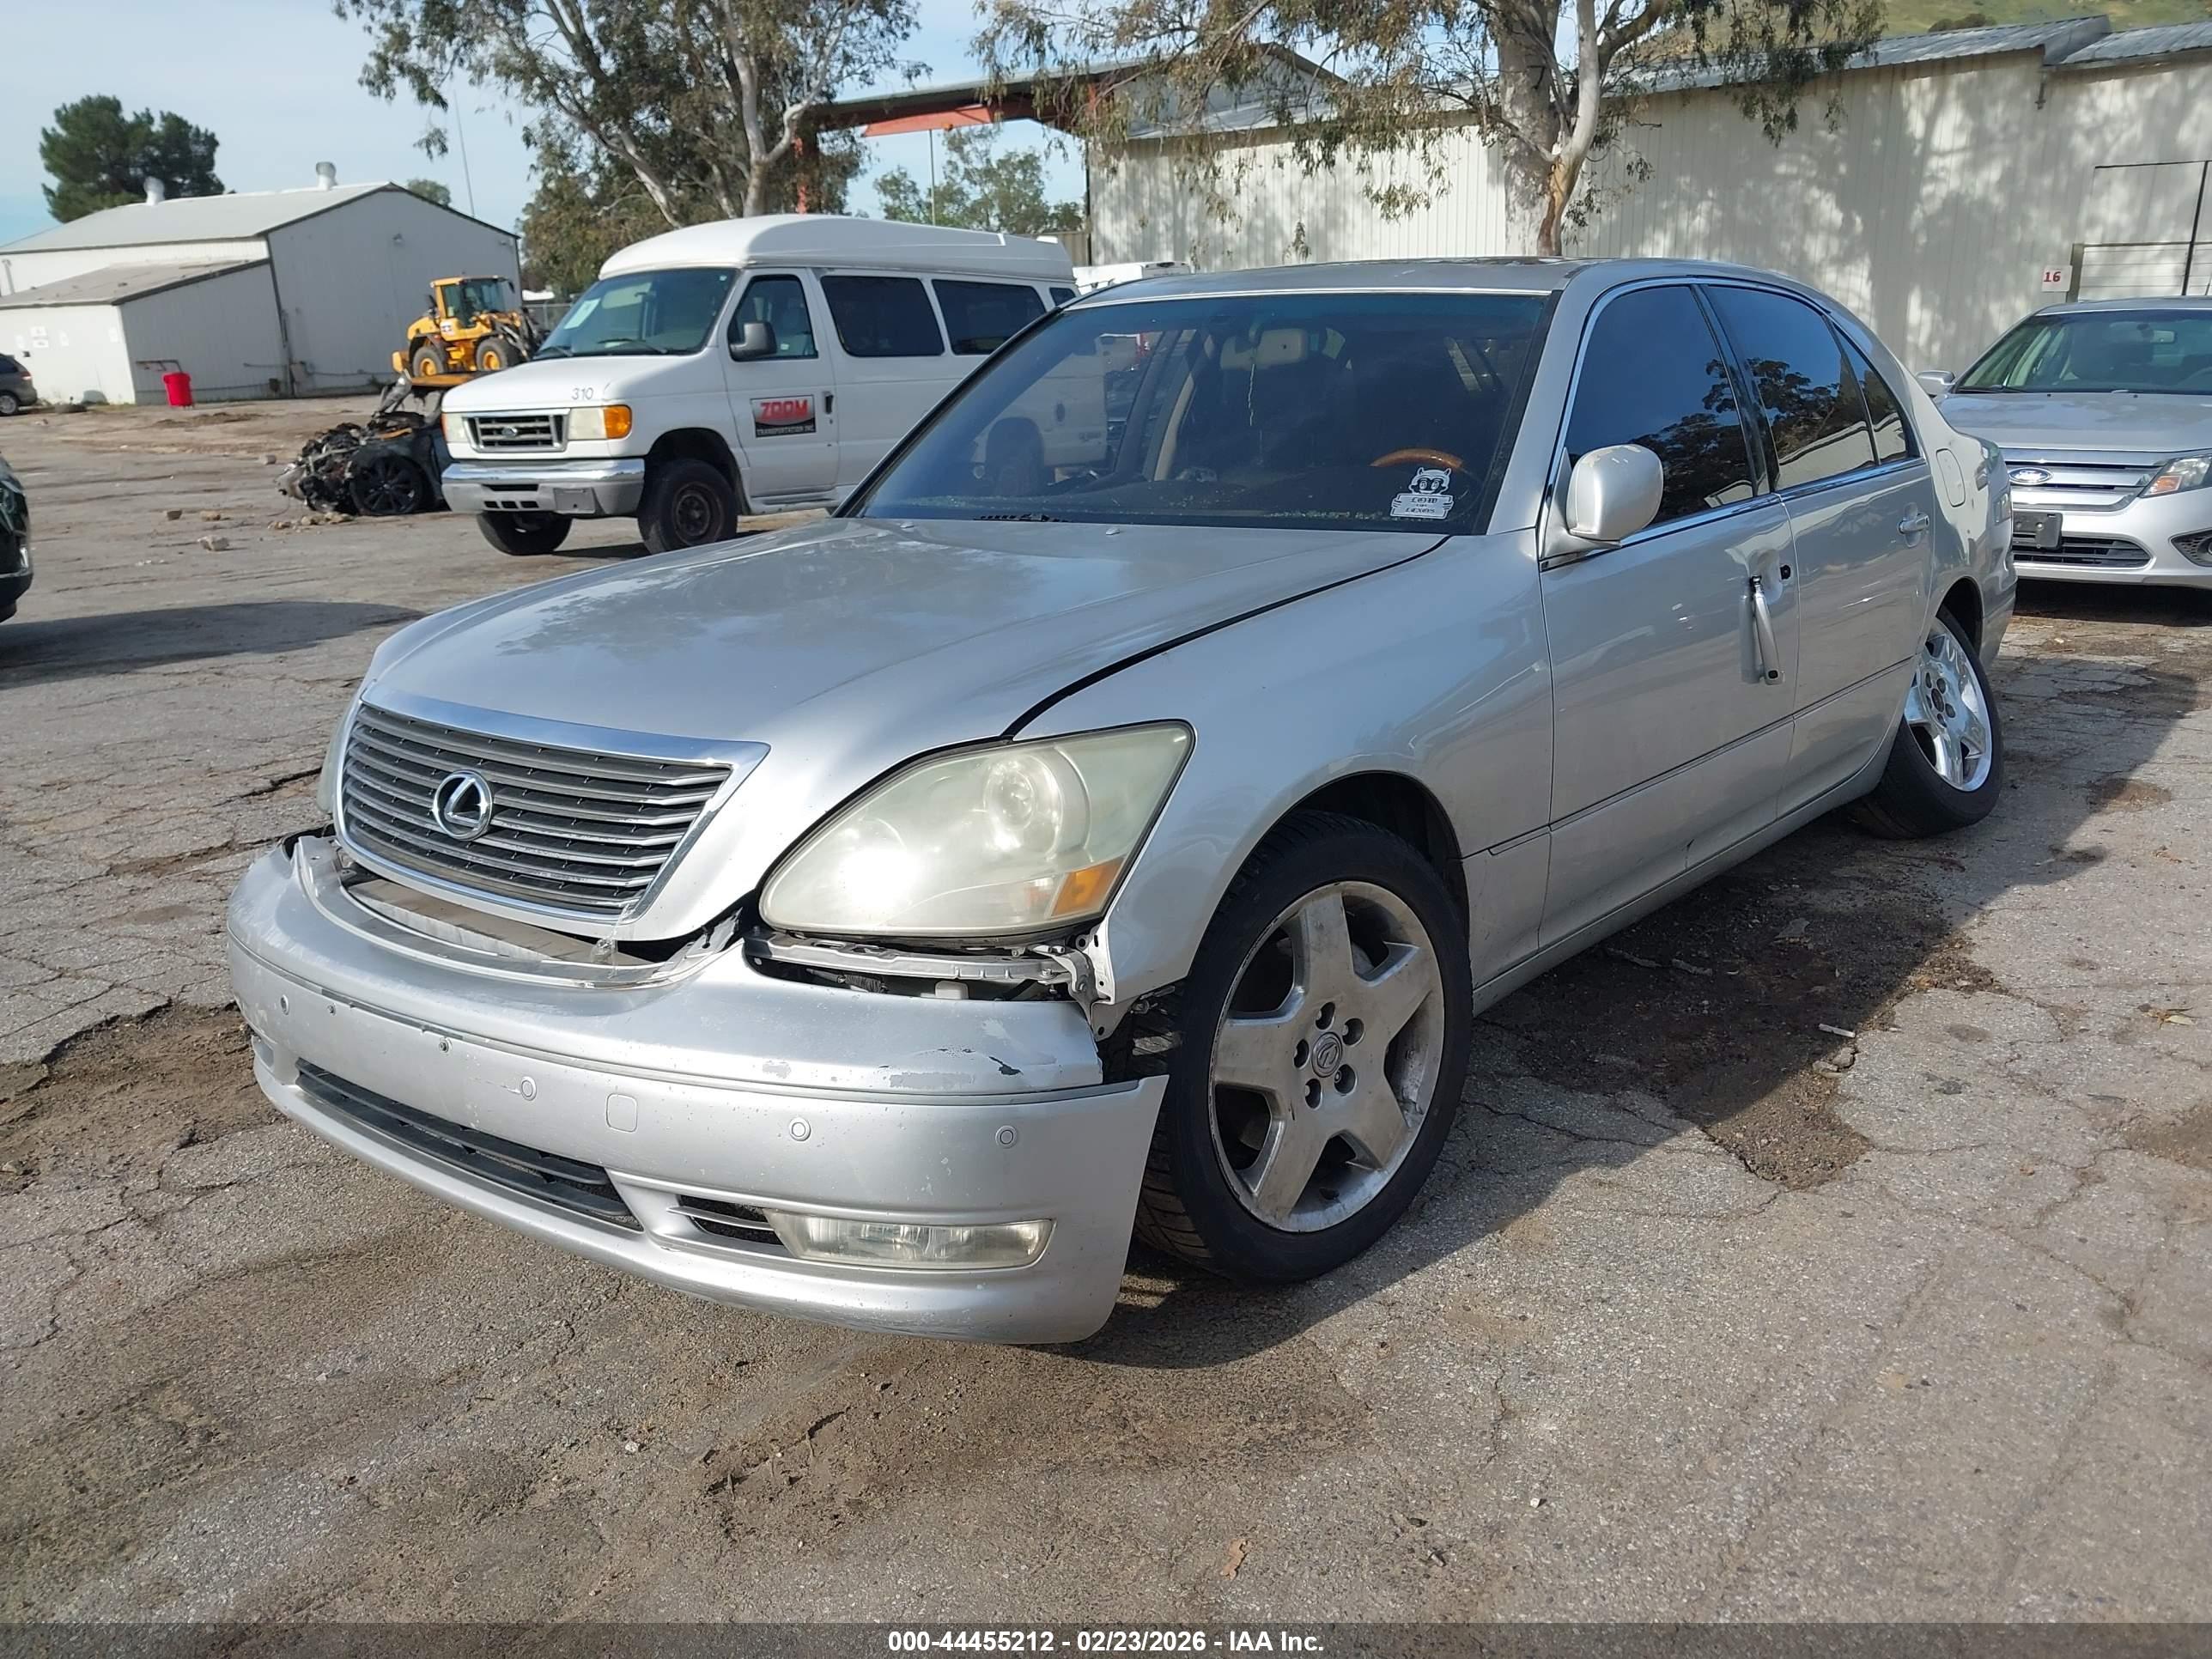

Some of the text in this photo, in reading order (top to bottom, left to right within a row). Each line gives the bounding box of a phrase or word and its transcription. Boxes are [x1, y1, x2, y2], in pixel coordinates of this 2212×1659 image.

[2043, 270, 2062, 283] 16
[570, 387, 594, 400] 310
[760, 399, 810, 422] ZOOM
